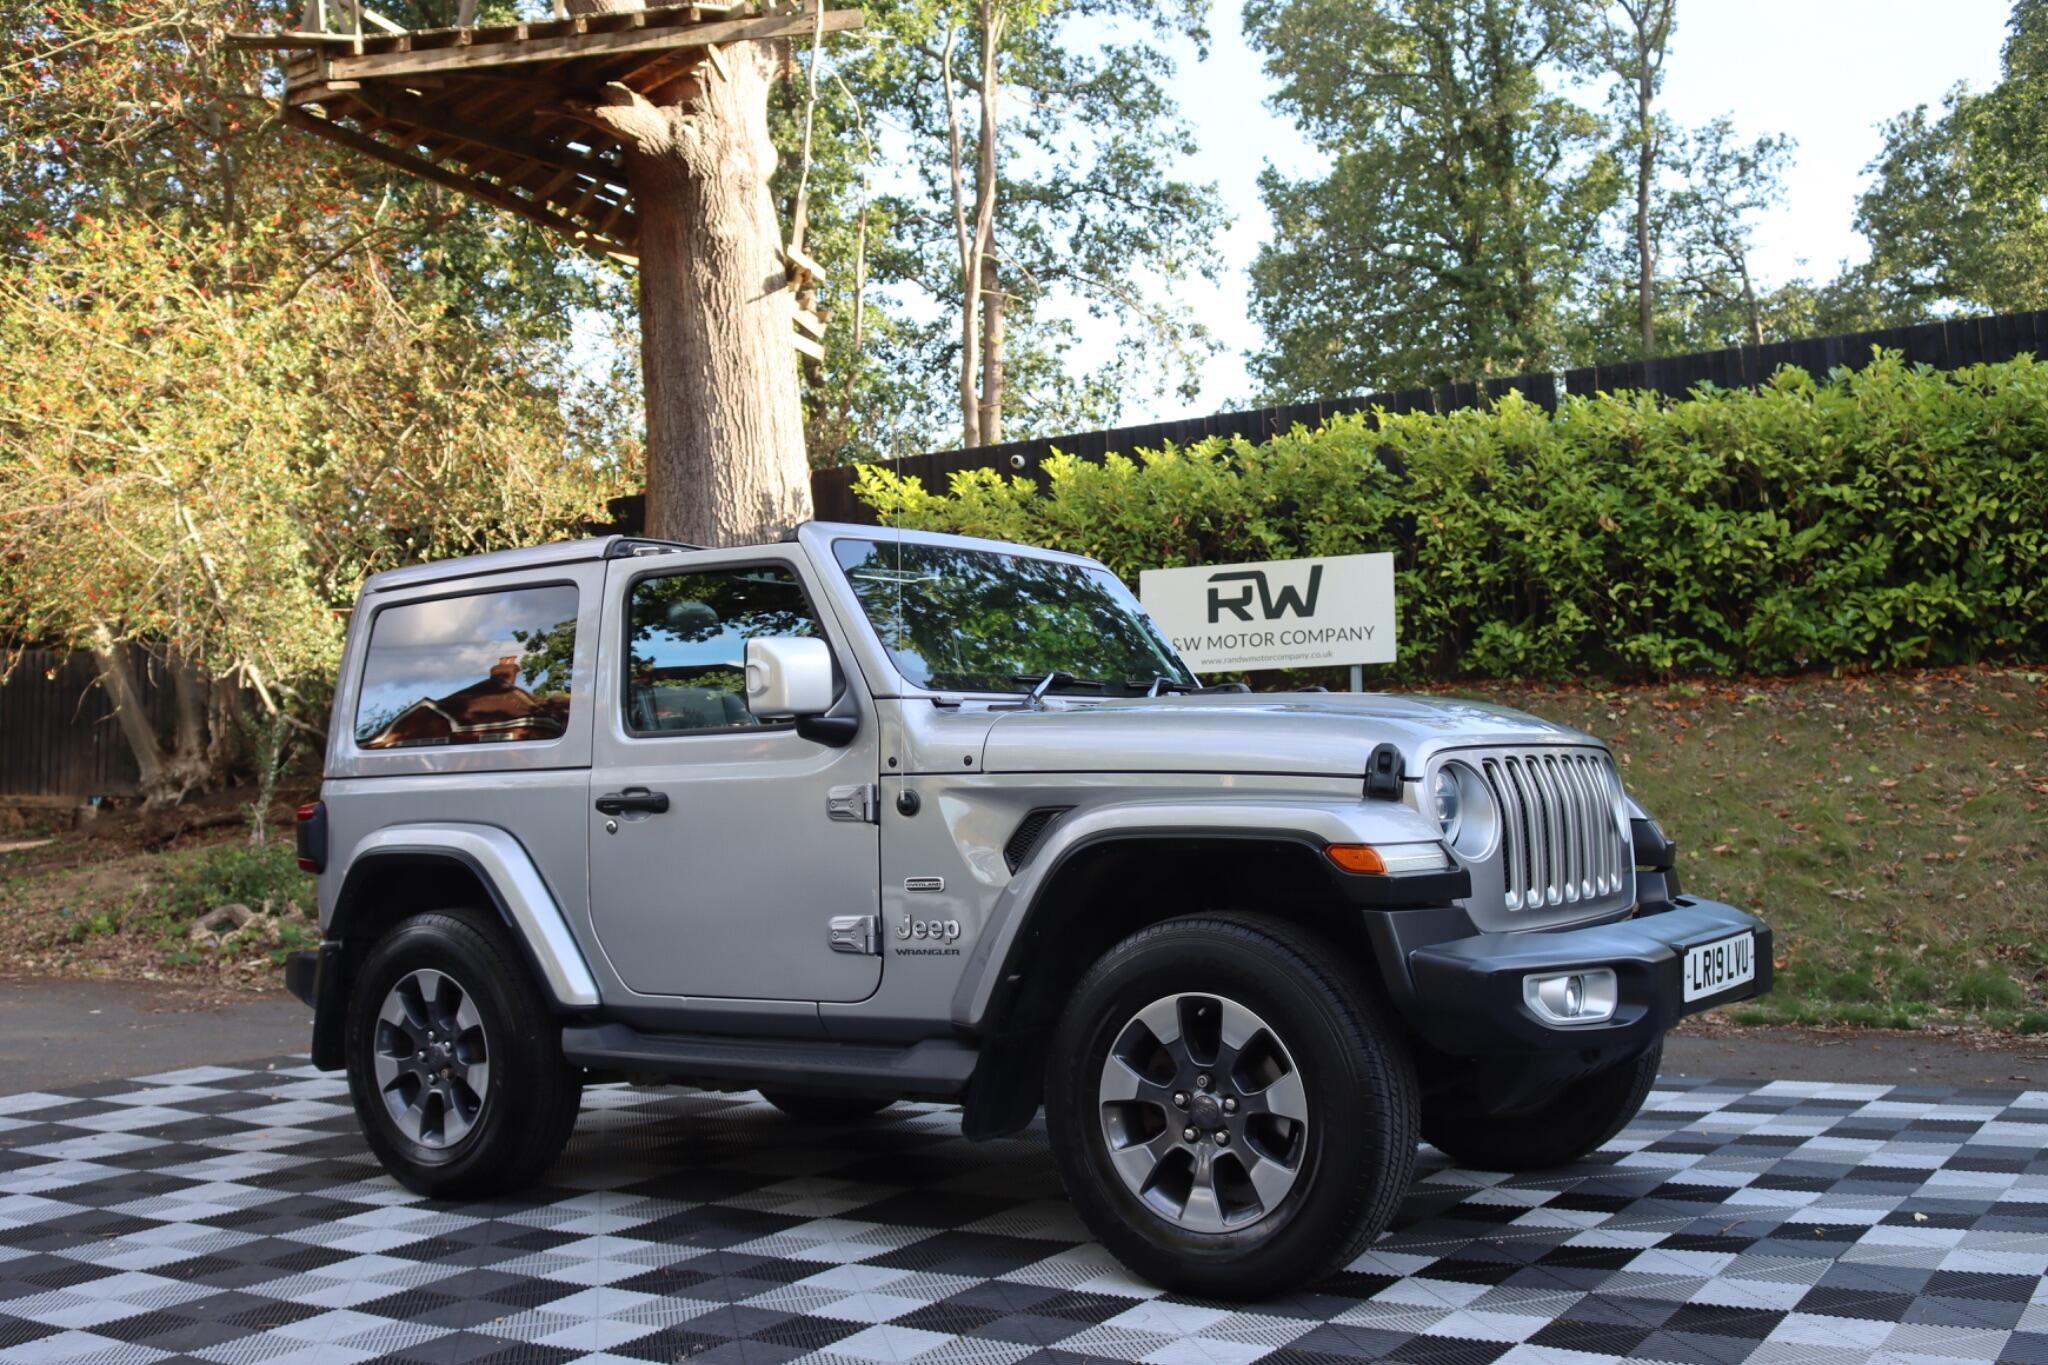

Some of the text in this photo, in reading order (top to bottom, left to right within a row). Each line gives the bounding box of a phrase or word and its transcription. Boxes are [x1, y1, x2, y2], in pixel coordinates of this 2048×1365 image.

[1207, 564, 1323, 624] RW
[1172, 625, 1375, 652] &W MOTOR COMPANY
[1200, 650, 1333, 666] www.randwmotorcompany.co.uk
[896, 913, 961, 945] Jeep
[895, 948, 960, 956] WRANGLER
[1693, 937, 1749, 991] LR19 LVU
